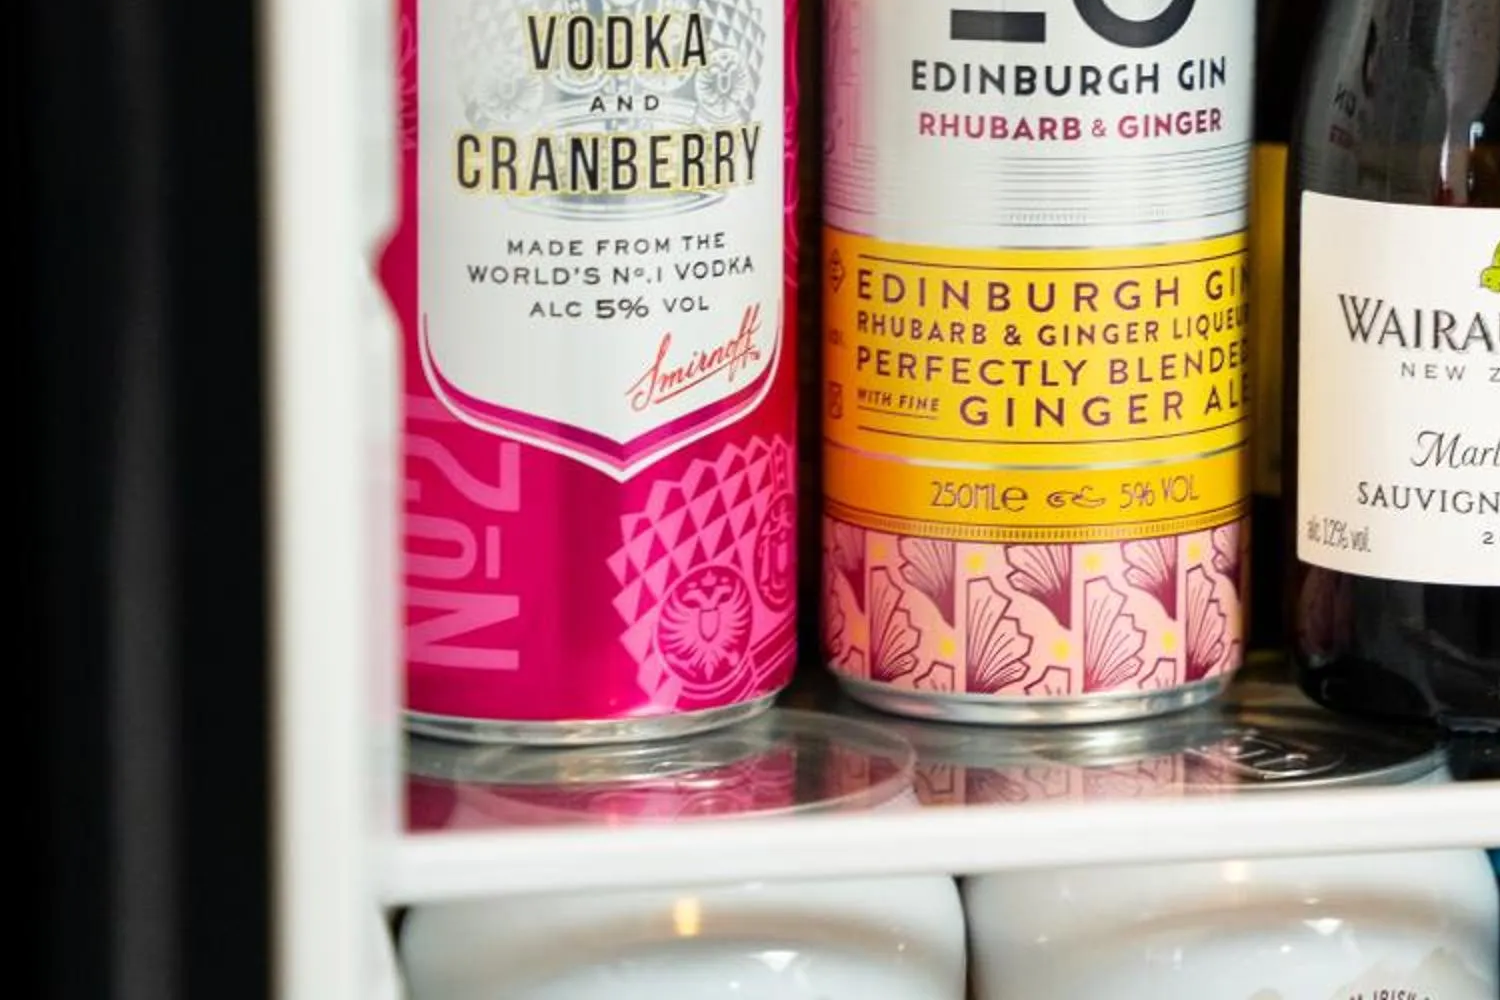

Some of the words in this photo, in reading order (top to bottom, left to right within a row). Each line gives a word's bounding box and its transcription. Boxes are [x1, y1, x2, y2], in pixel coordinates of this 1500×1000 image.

[528, 13, 706, 70] VODKA
[910, 59, 1160, 97] EDINBURGH
[1176, 55, 1228, 91] GIN
[589, 95, 659, 112] AND
[919, 112, 1081, 141] RHUBARB
[1090, 120, 1107, 138] &
[1117, 108, 1222, 139] GINGER
[456, 125, 761, 191] CRANBERRY
[507, 239, 583, 256] MADE
[597, 238, 670, 256] FROM
[682, 232, 726, 251] THE
[466, 264, 601, 285] WORLD'S
[674, 256, 755, 282] VODKA
[529, 301, 582, 318] ALC
[595, 299, 650, 320] 5%
[661, 296, 710, 314] VOL
[857, 268, 1181, 313] EDINBURGH
[857, 310, 987, 346] RHUBARB
[1002, 325, 1022, 346] &
[1037, 321, 1160, 346] GINGER
[625, 304, 763, 413] Smirnoff
[857, 345, 1088, 387] PERFECTLY
[1400, 361, 1467, 381] NEW
[899, 394, 940, 412] FINE
[959, 390, 1185, 428] GINGER
[1119, 482, 1156, 510] 5%
[1161, 474, 1200, 503] VOL
